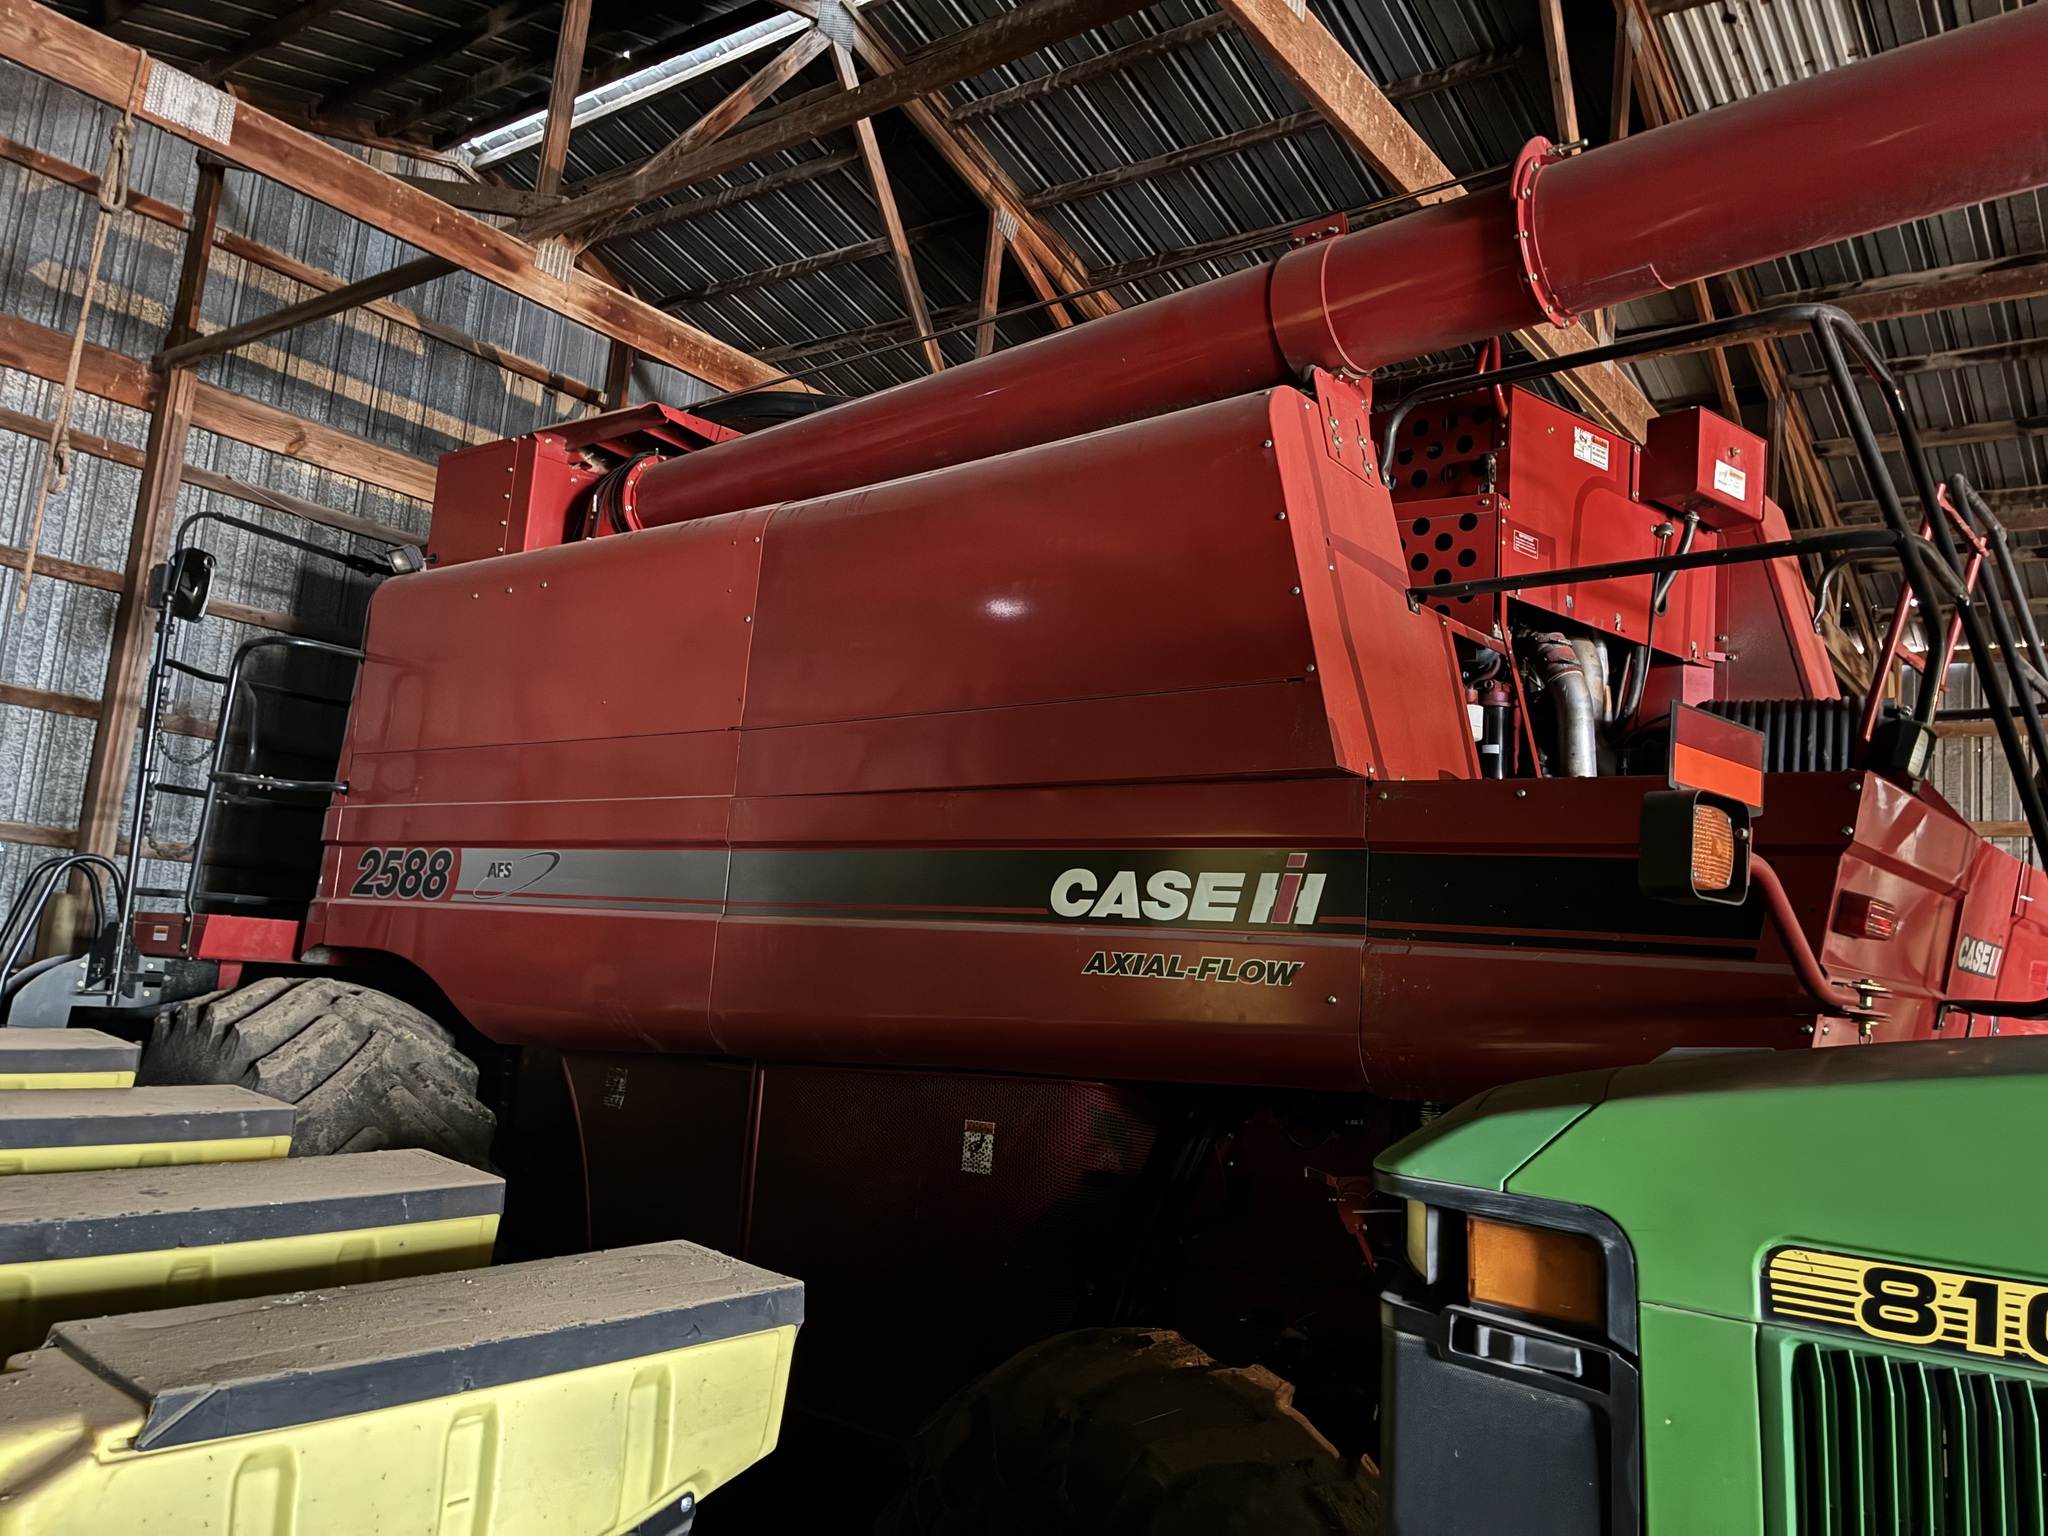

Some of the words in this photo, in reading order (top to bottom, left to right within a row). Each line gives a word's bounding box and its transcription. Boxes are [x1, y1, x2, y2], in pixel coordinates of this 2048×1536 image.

[350, 847, 454, 901] 2588
[486, 861, 513, 879] AFS
[1050, 867, 1246, 923] CASE
[1081, 951, 1305, 987] AXIAL-FLOW
[1958, 935, 1993, 974] CASE
